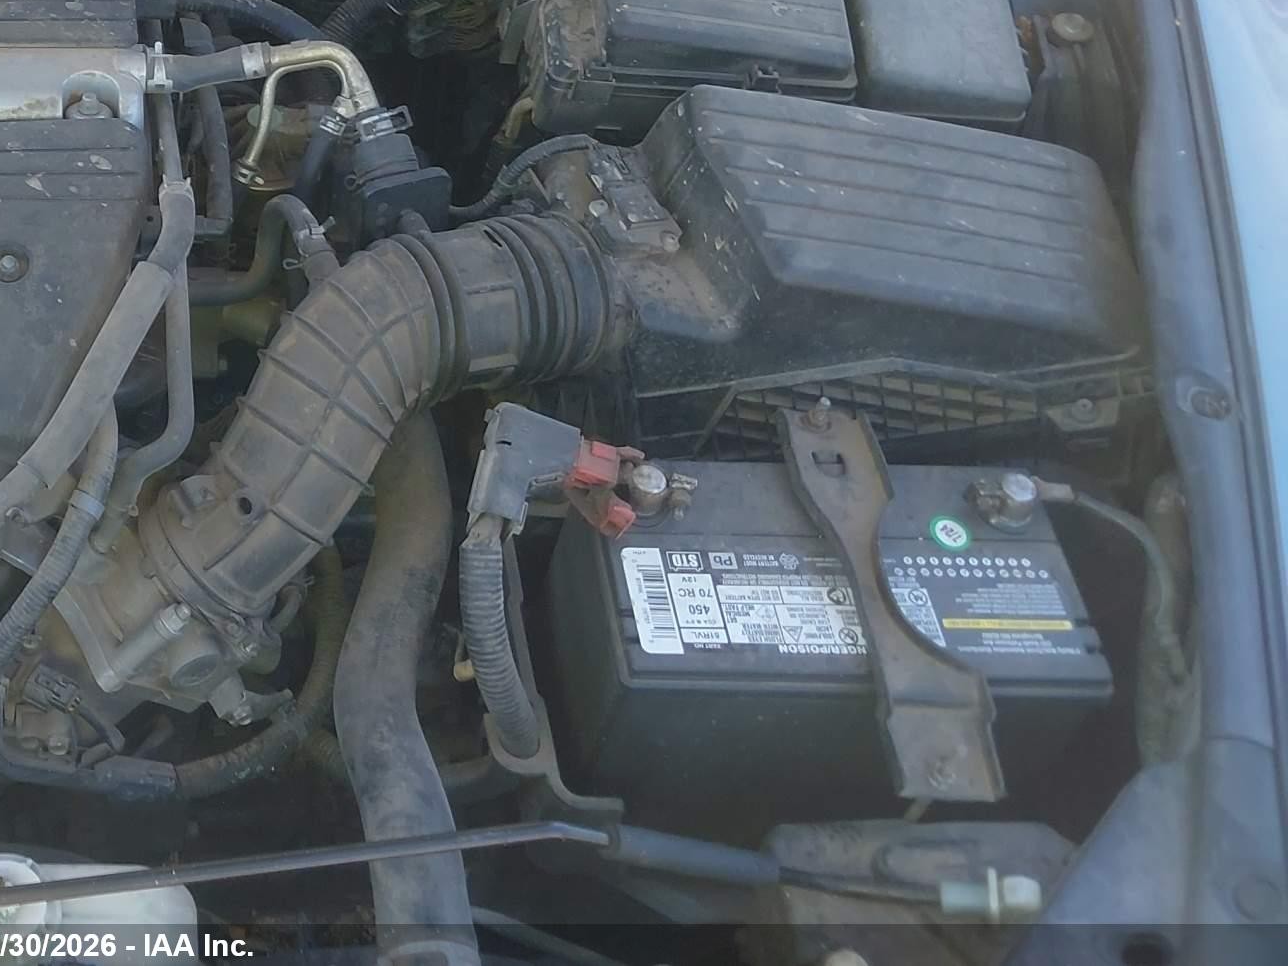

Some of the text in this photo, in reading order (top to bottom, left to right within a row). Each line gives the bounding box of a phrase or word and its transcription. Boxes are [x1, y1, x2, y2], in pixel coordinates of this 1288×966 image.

[672, 554, 699, 567] STD
[713, 555, 732, 567] Pb
[678, 588, 713, 598] 70 RC
[688, 604, 710, 616] 450
